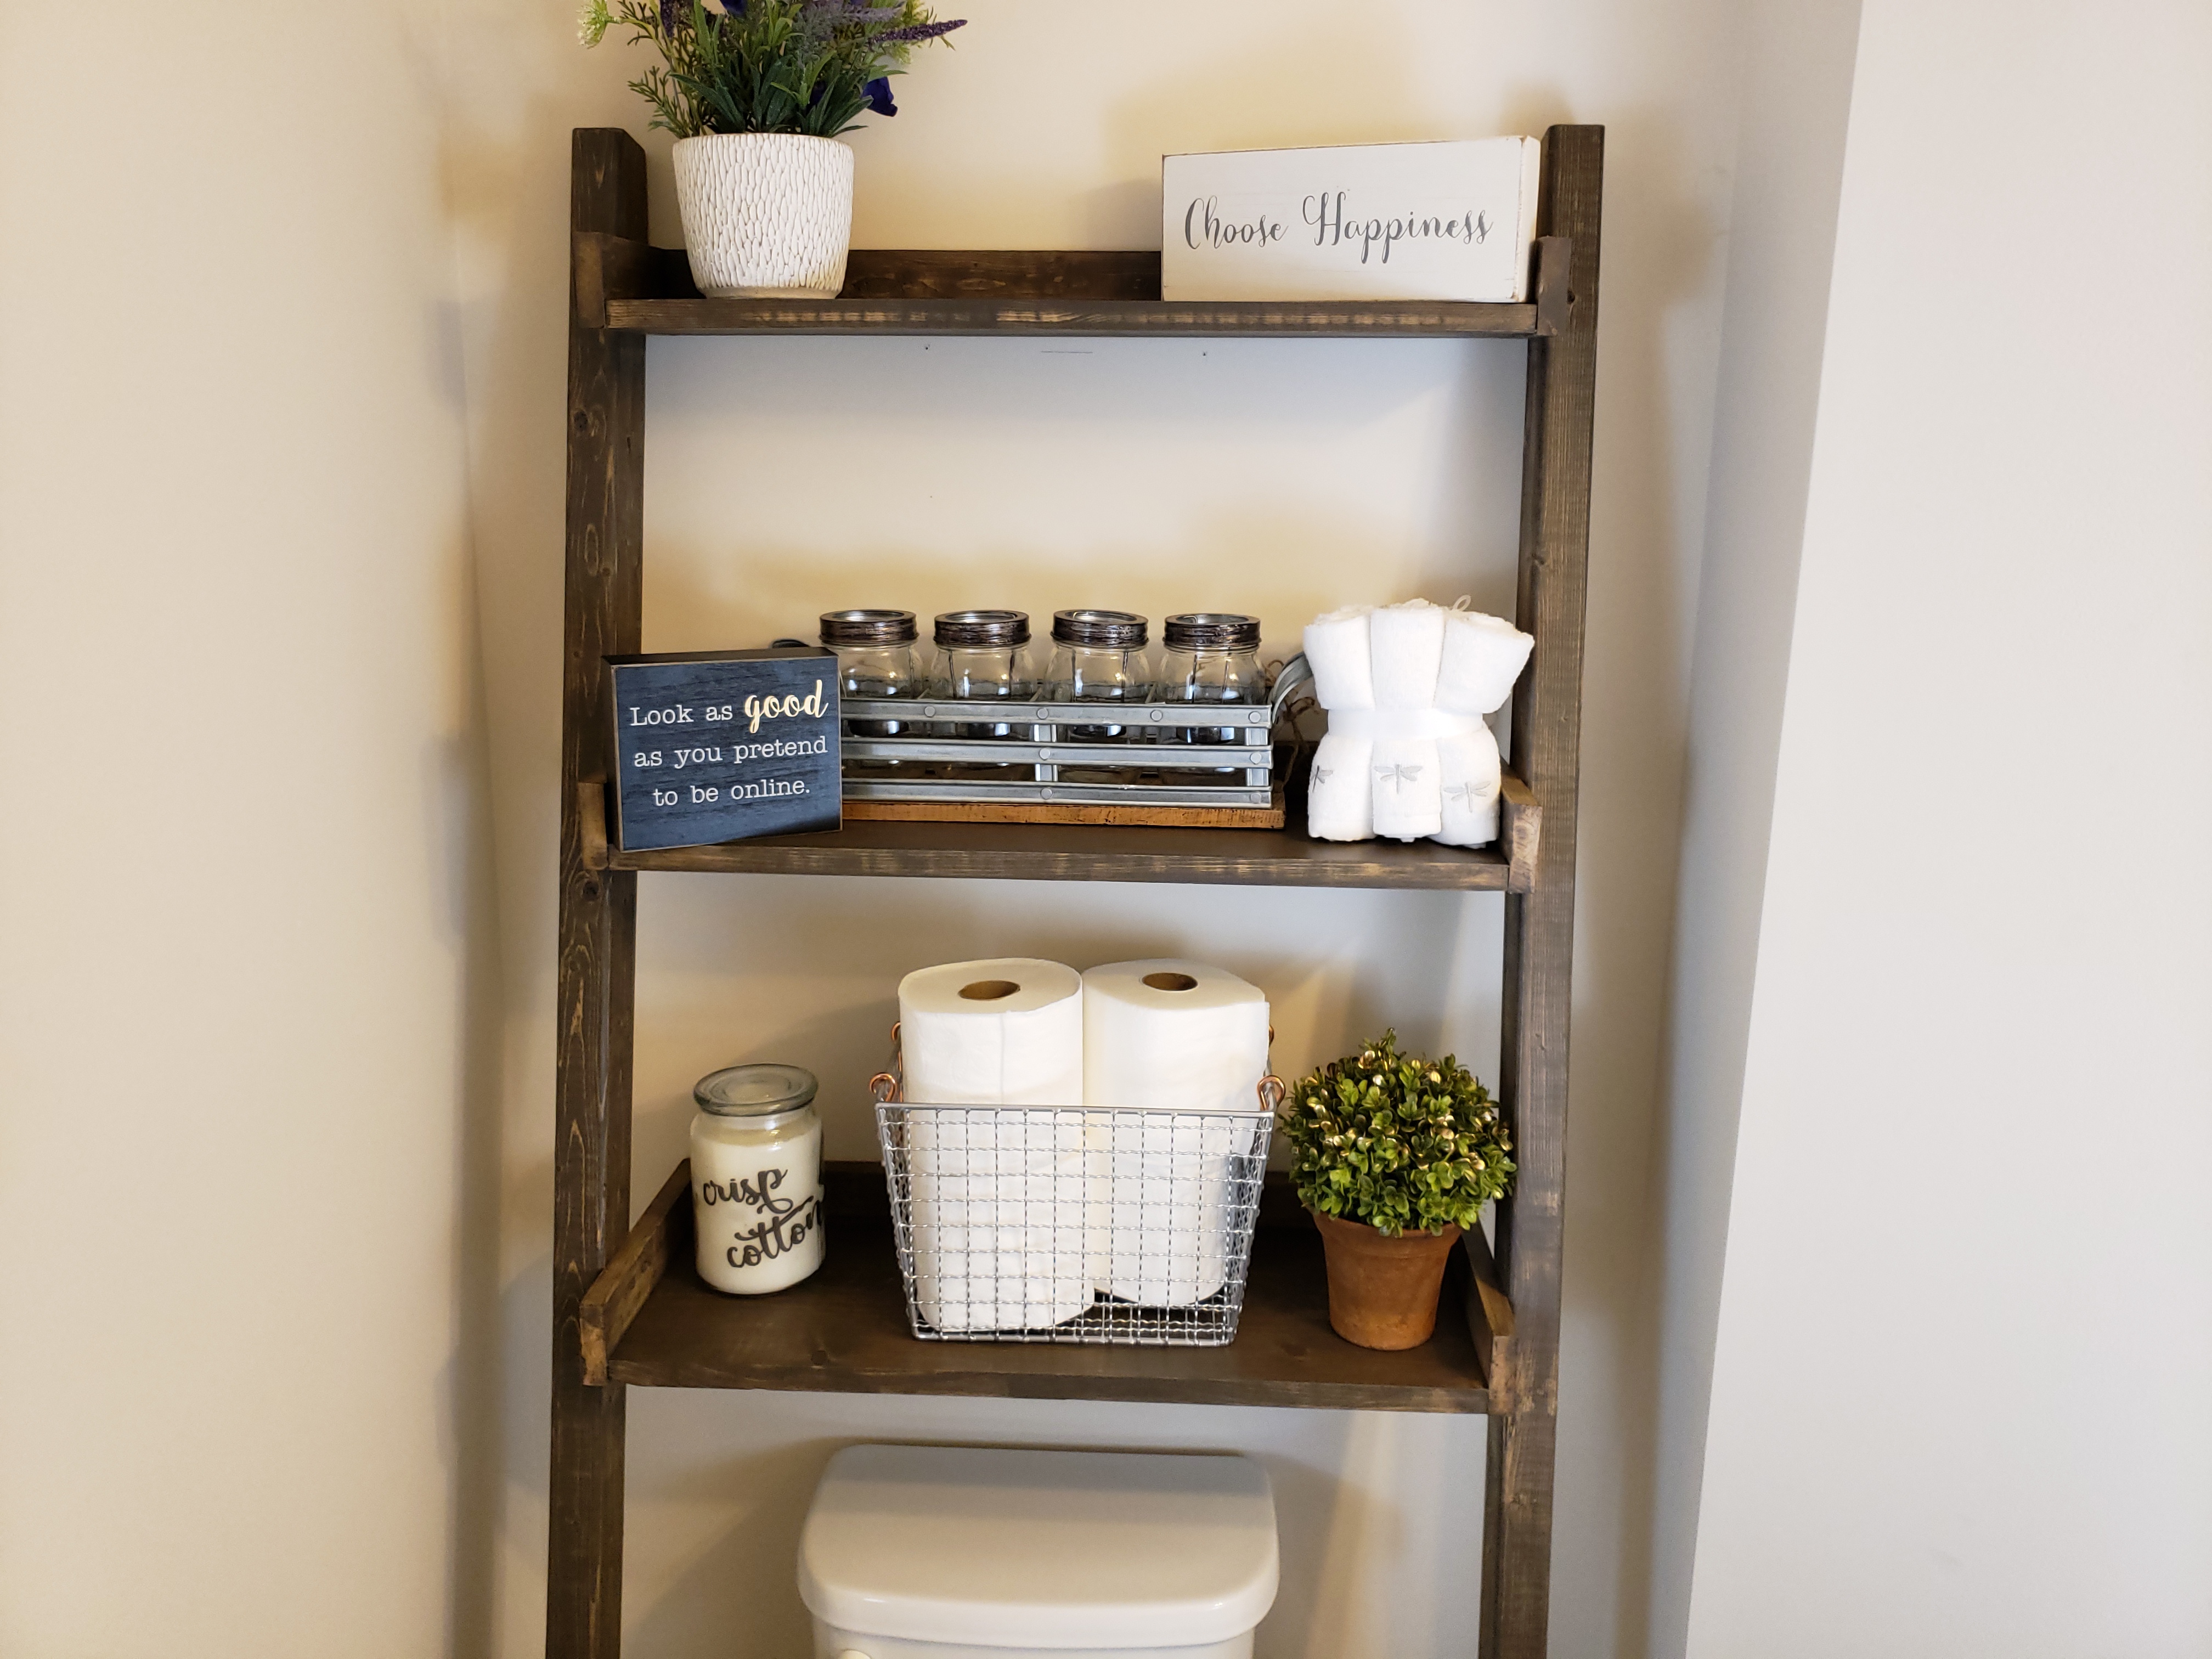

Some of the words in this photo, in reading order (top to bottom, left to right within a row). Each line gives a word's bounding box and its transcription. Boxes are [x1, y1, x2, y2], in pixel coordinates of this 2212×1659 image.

[1184, 195, 1288, 250] Choose
[1302, 191, 1493, 264] Happiness
[629, 704, 694, 726] Look
[706, 704, 733, 721] as
[744, 679, 829, 734] good
[634, 750, 663, 768] as
[674, 746, 723, 769] you
[733, 735, 828, 764] pretend
[653, 788, 679, 806] to
[690, 785, 719, 804] be
[731, 779, 810, 800] online.
[703, 1168, 794, 1215] crisp
[726, 1195, 822, 1268] cotton
